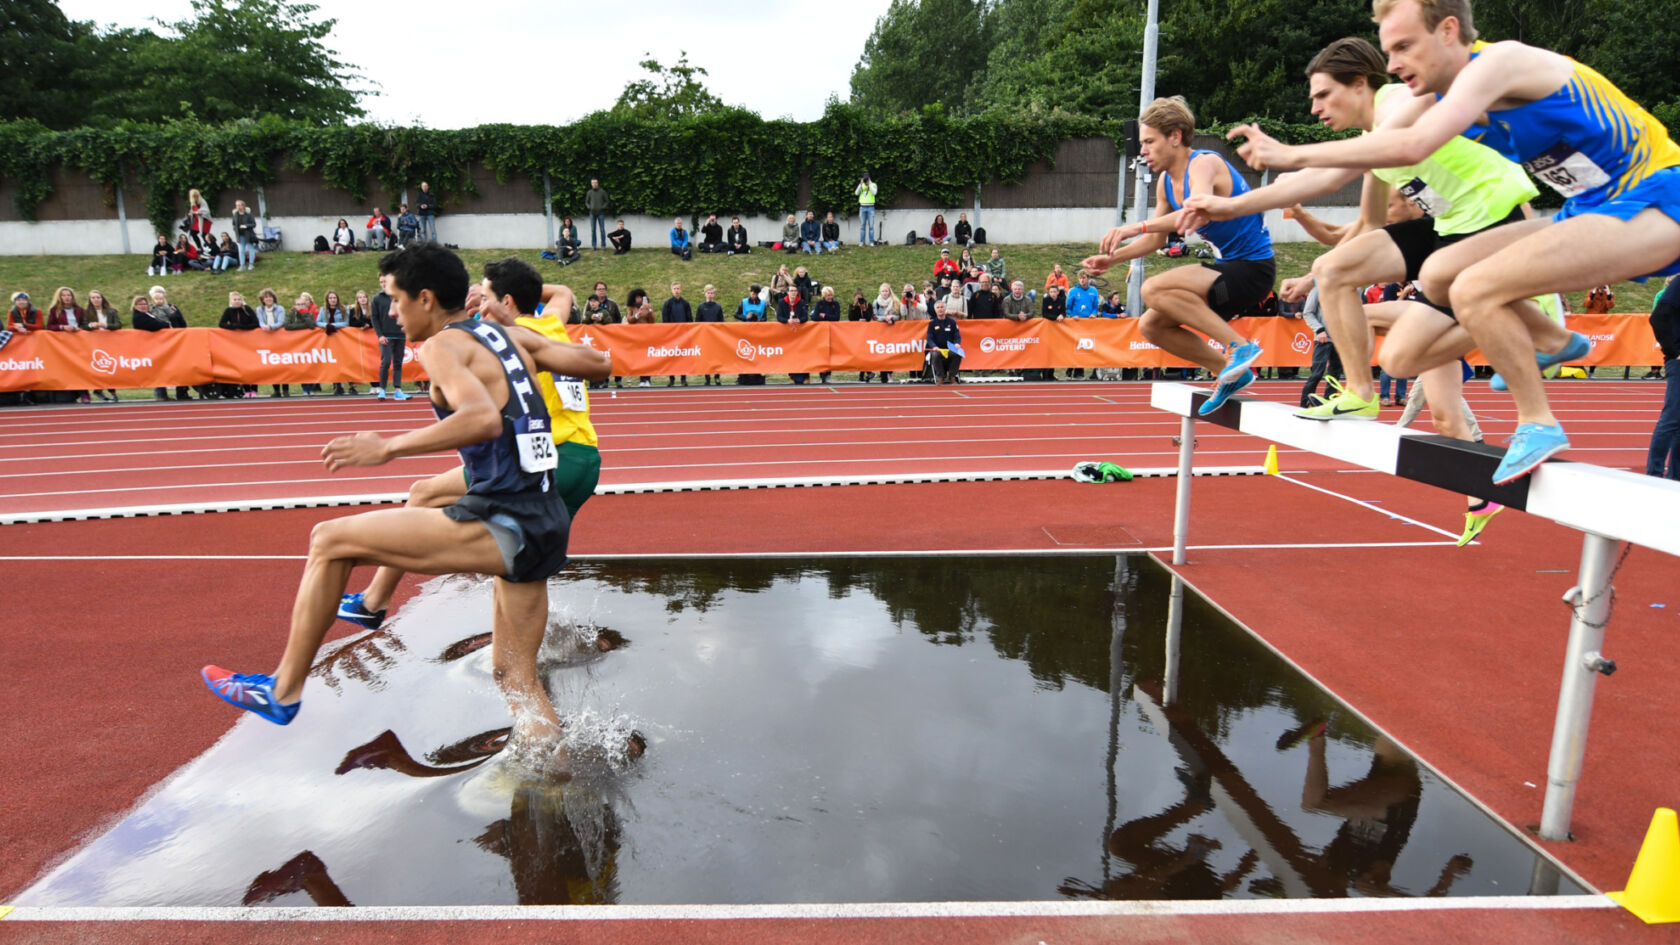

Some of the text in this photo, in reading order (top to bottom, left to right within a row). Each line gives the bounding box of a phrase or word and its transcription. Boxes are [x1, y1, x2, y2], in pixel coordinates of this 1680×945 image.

[1077, 338, 1094, 350] AD
[257, 349, 337, 364] TeamNL
[647, 345, 701, 358] Rabobank
[758, 345, 783, 357] kpn
[119, 356, 152, 370] kpn
